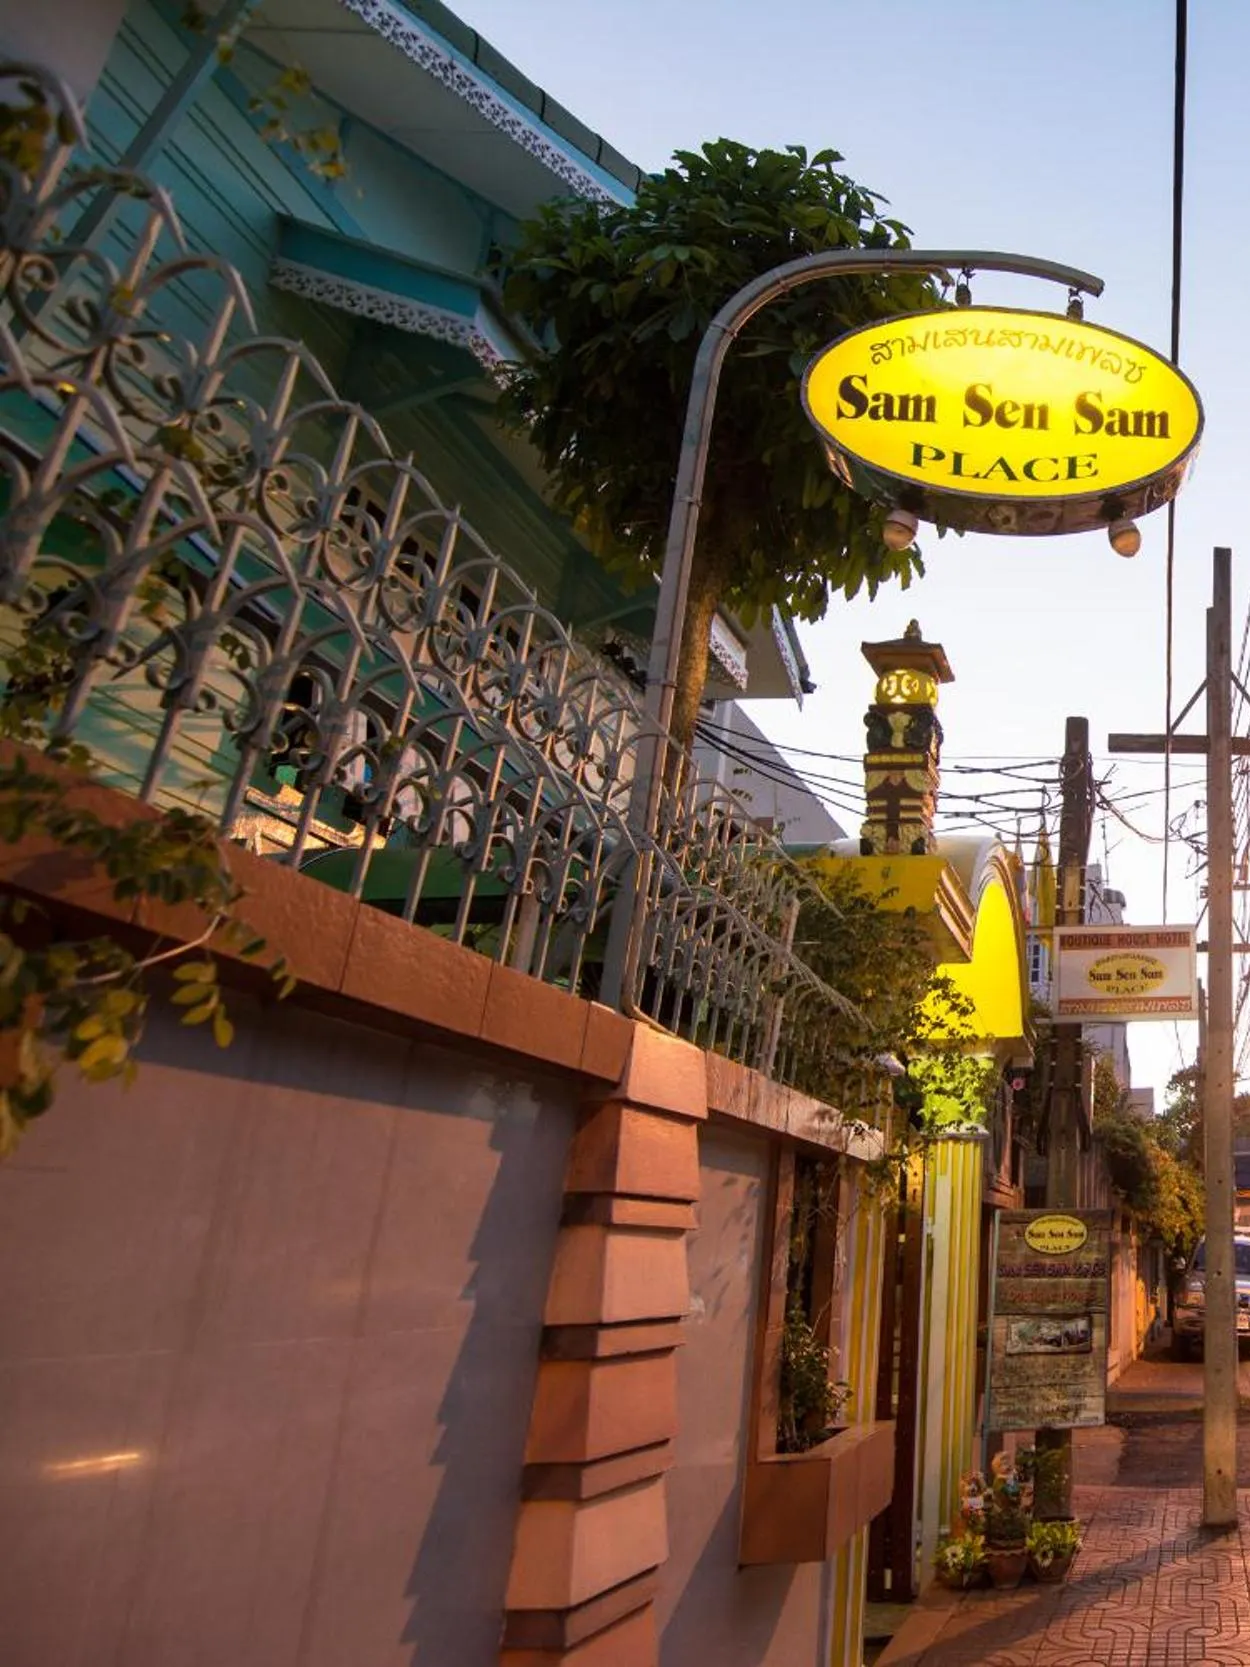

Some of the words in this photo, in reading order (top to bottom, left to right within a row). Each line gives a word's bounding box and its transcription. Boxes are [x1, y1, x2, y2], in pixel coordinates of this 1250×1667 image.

[836, 373, 937, 424] Sam
[963, 382, 1050, 432] Sen
[1073, 390, 1172, 440] Sam
[909, 441, 1099, 483] PLACE
[1089, 969, 1112, 981] Sam
[1116, 967, 1136, 981] Sen
[1141, 967, 1163, 980] Sam
